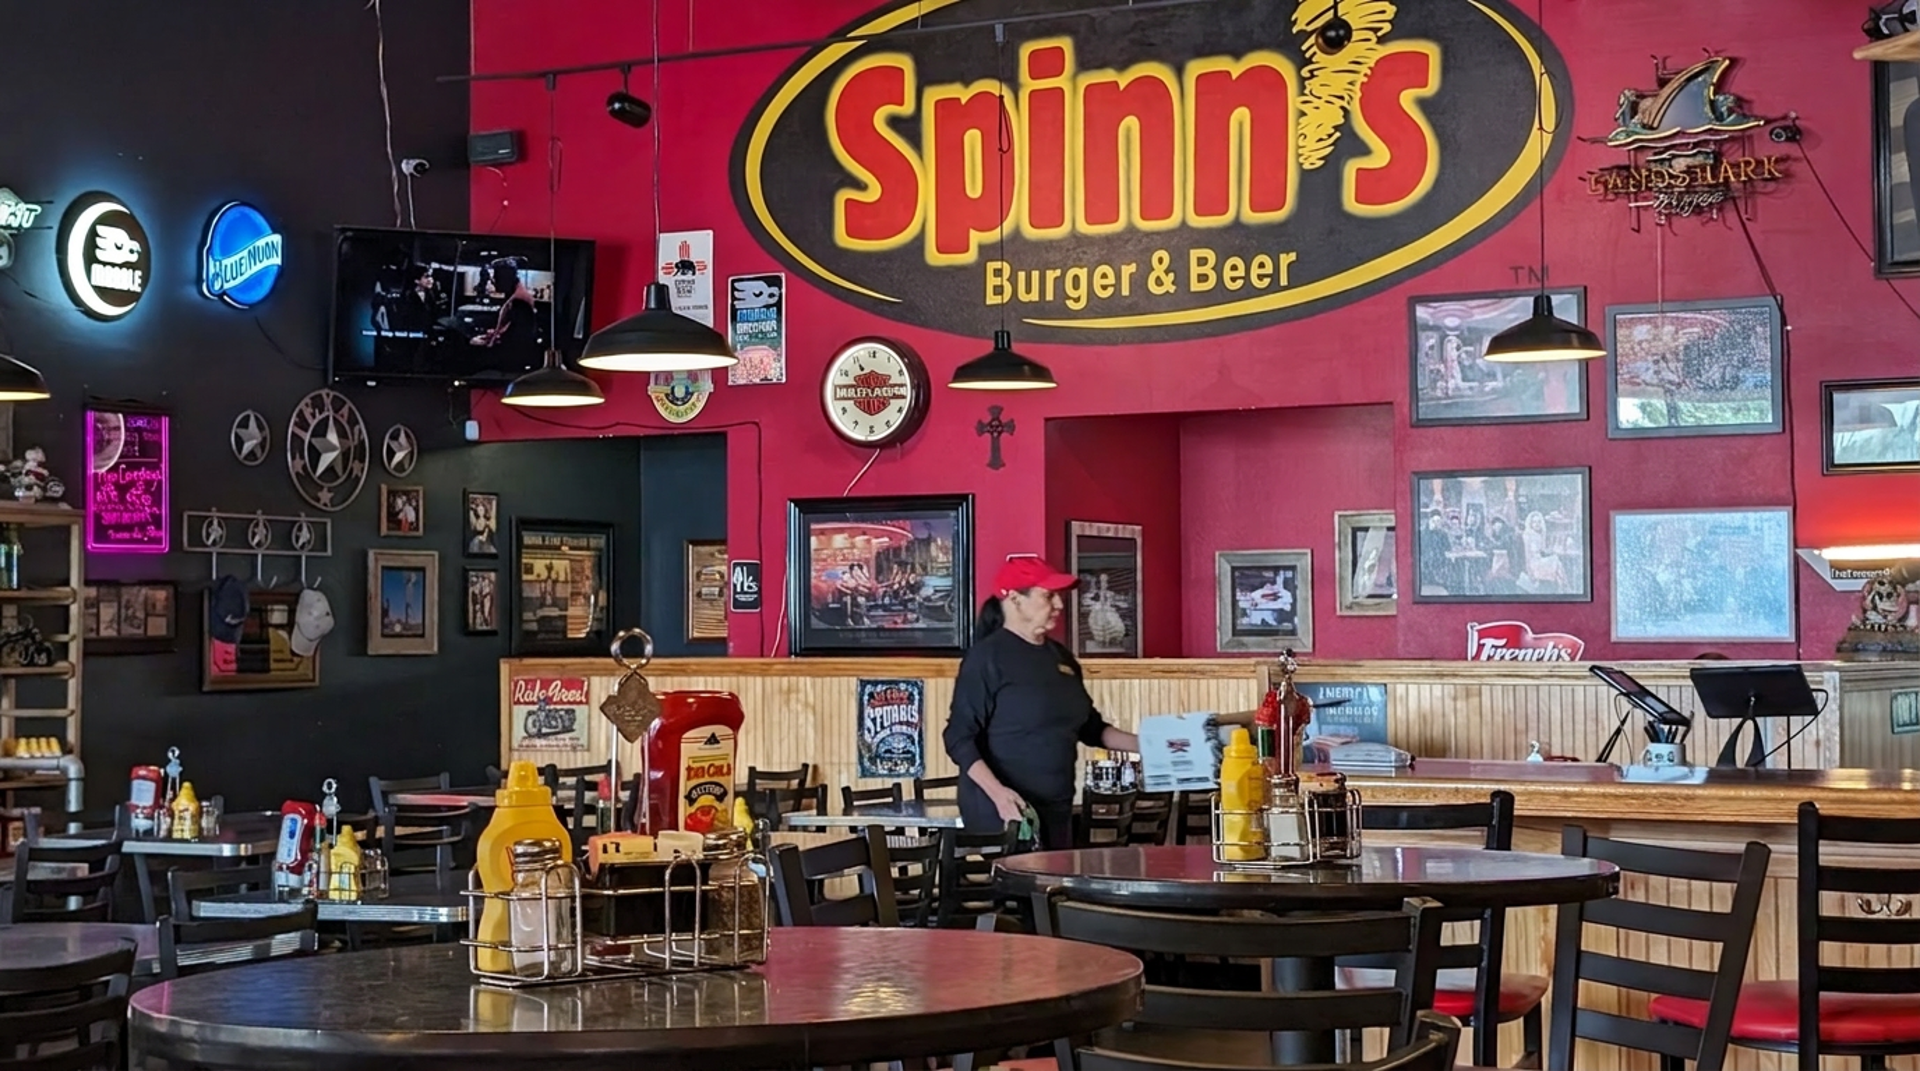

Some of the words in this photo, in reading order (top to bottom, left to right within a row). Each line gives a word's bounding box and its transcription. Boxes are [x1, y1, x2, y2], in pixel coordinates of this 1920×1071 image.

[826, 36, 1441, 265] Spinn's
[985, 263, 1137, 311] Burger
[1147, 249, 1176, 295] &
[1189, 248, 1297, 292] Beer
